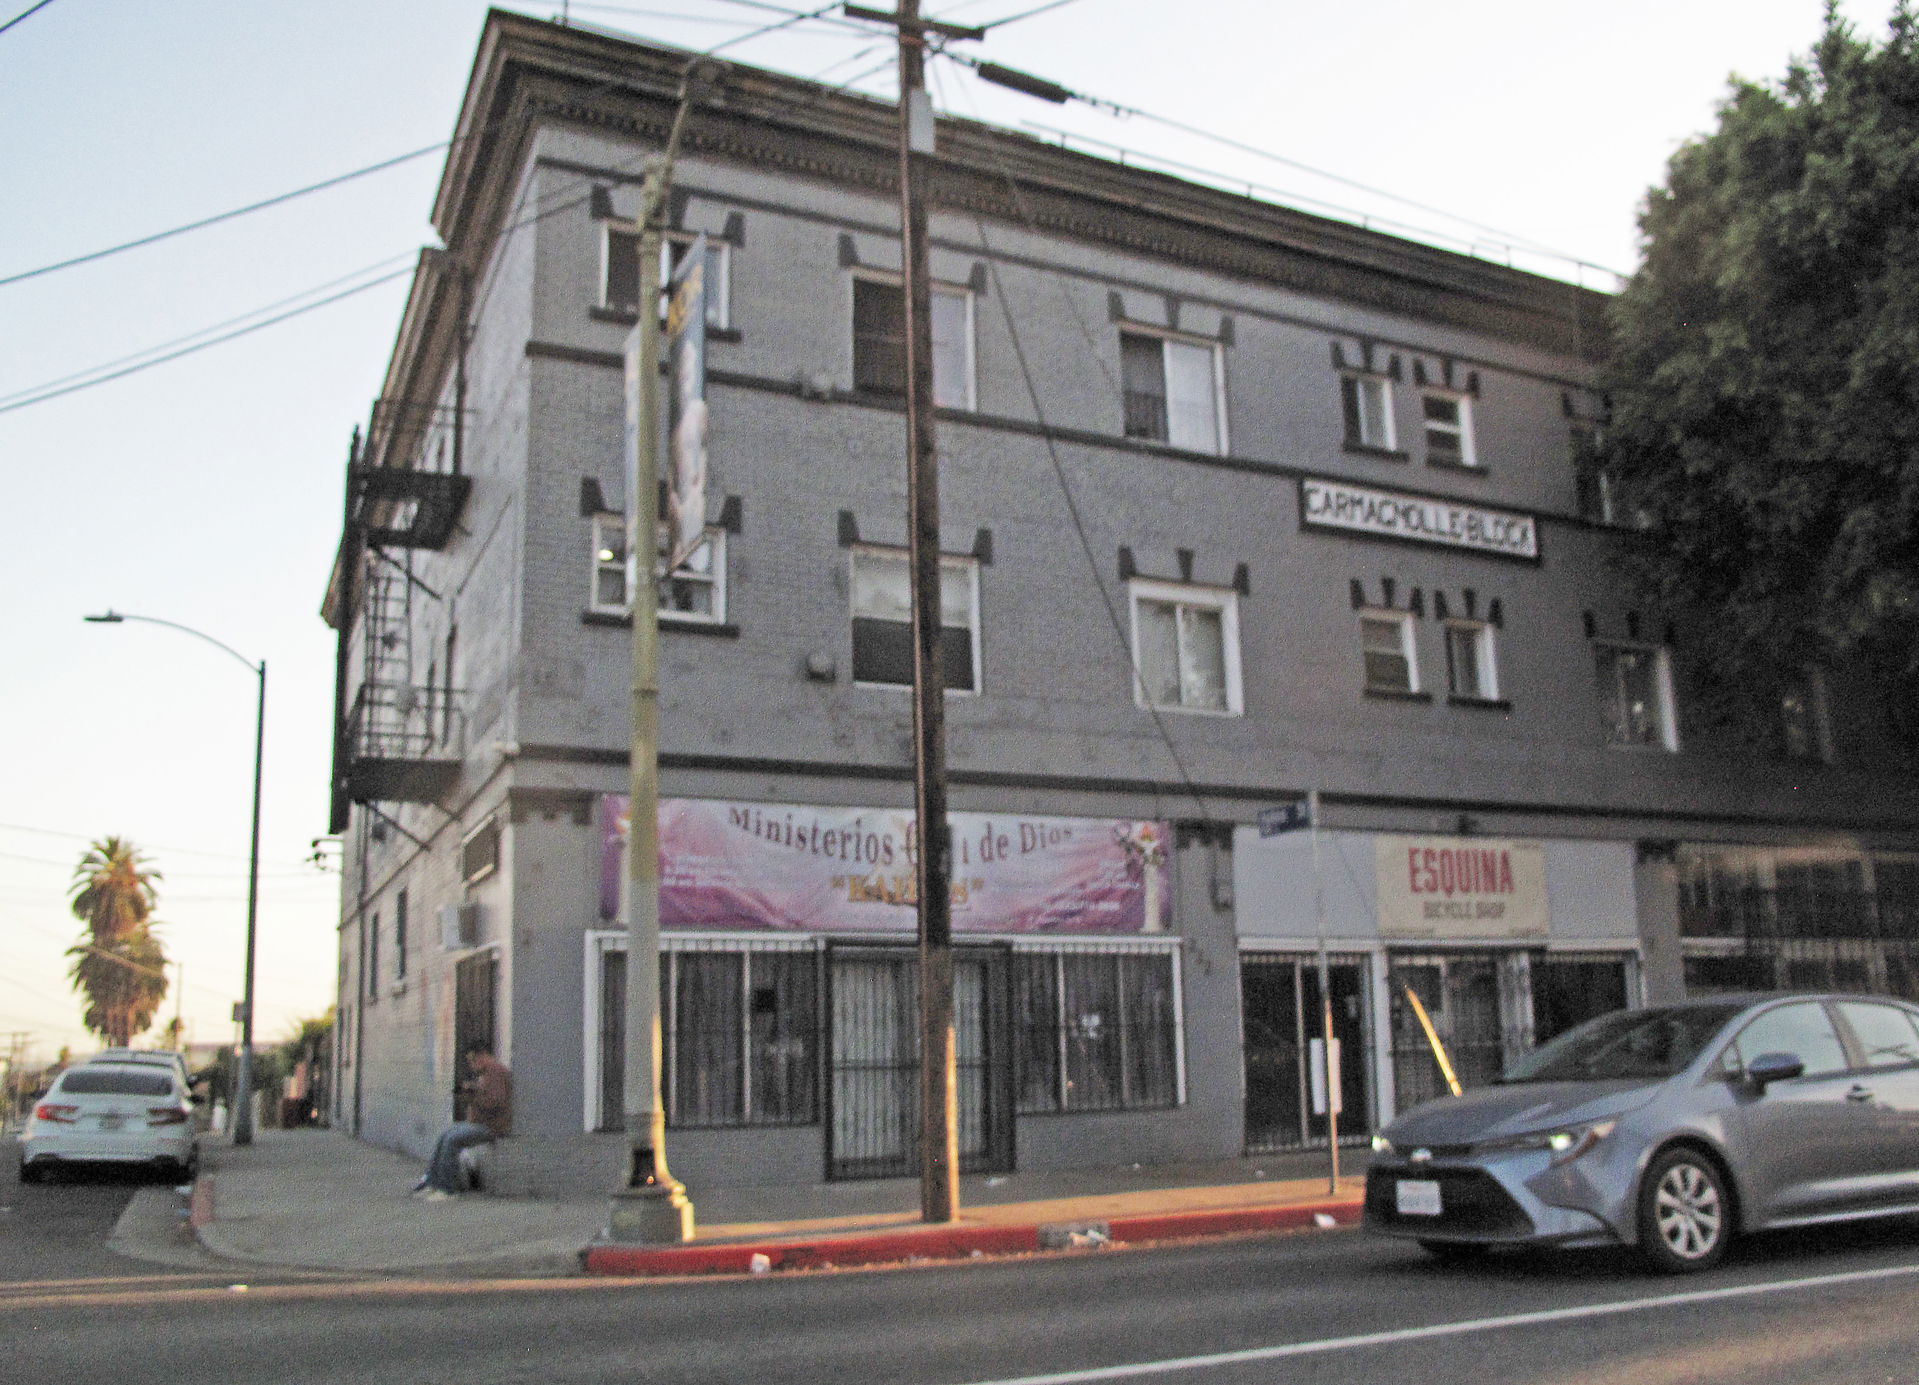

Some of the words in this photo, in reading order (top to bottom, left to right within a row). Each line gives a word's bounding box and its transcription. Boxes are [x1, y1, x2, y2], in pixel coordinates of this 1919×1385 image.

[728, 805, 894, 865] Ministerios
[979, 822, 1009, 863] de
[1019, 821, 1073, 855] Dios
[1408, 847, 1515, 897] ESQUINA
